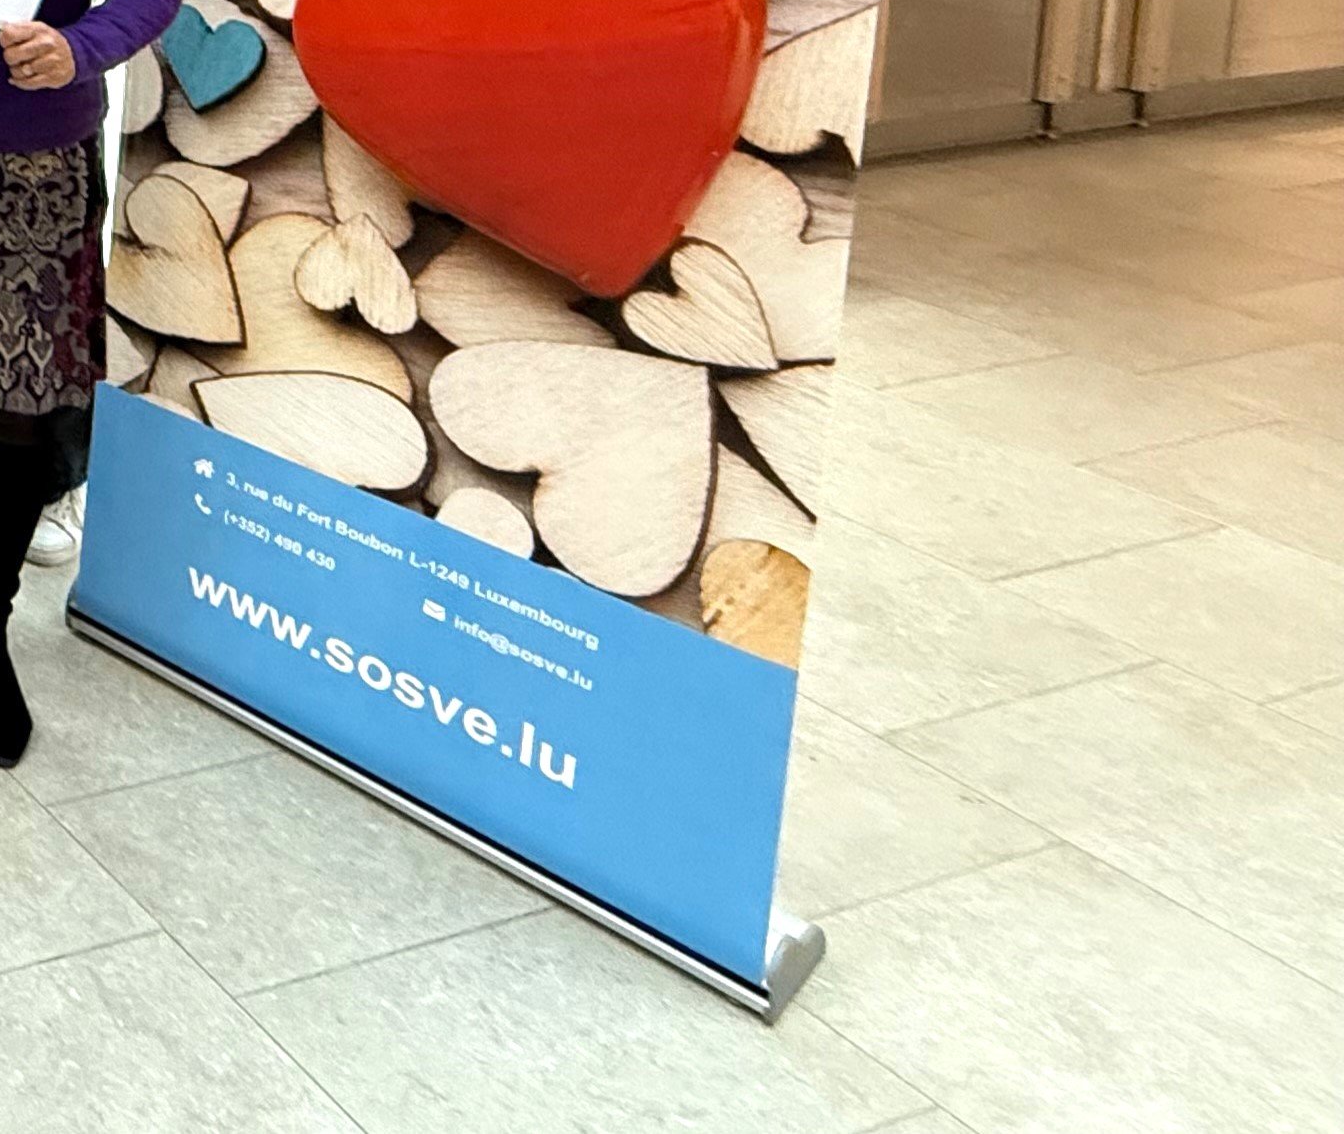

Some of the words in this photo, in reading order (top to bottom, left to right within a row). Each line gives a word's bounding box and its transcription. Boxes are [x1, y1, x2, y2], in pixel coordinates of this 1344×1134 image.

[224, 509, 270, 543] (+352)
[306, 548, 336, 571] 430
[244, 482, 269, 501] rue
[272, 494, 293, 513] du
[297, 502, 331, 530] Fort
[335, 519, 403, 560] Boubon
[409, 551, 470, 590] L-1249
[474, 581, 599, 651] Luxembourg
[189, 566, 578, 790] www.sosve.lu
[454, 614, 593, 691] info@sosve.lu
